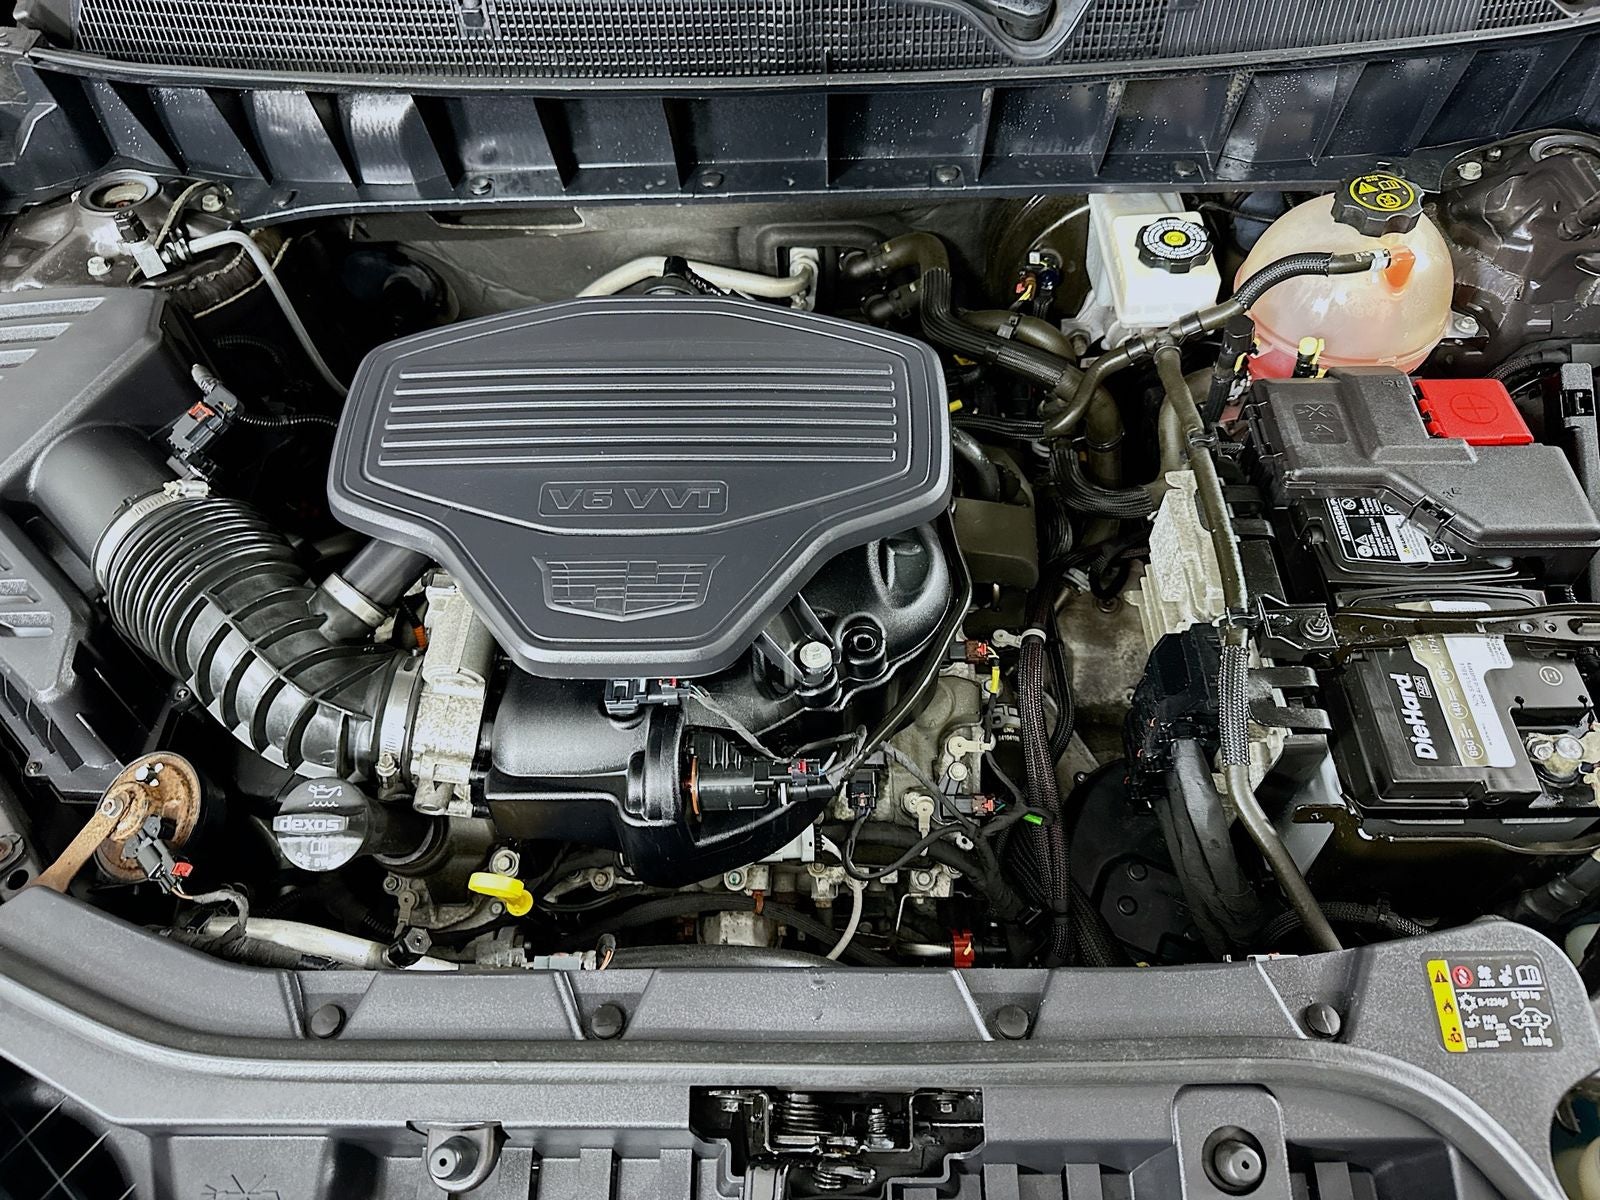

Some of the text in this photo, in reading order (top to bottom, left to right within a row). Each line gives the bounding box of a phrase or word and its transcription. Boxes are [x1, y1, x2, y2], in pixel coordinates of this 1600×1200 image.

[548, 488, 720, 509] V6 VVT
[1390, 673, 1439, 760] DieHard
[279, 816, 342, 831] dexos
